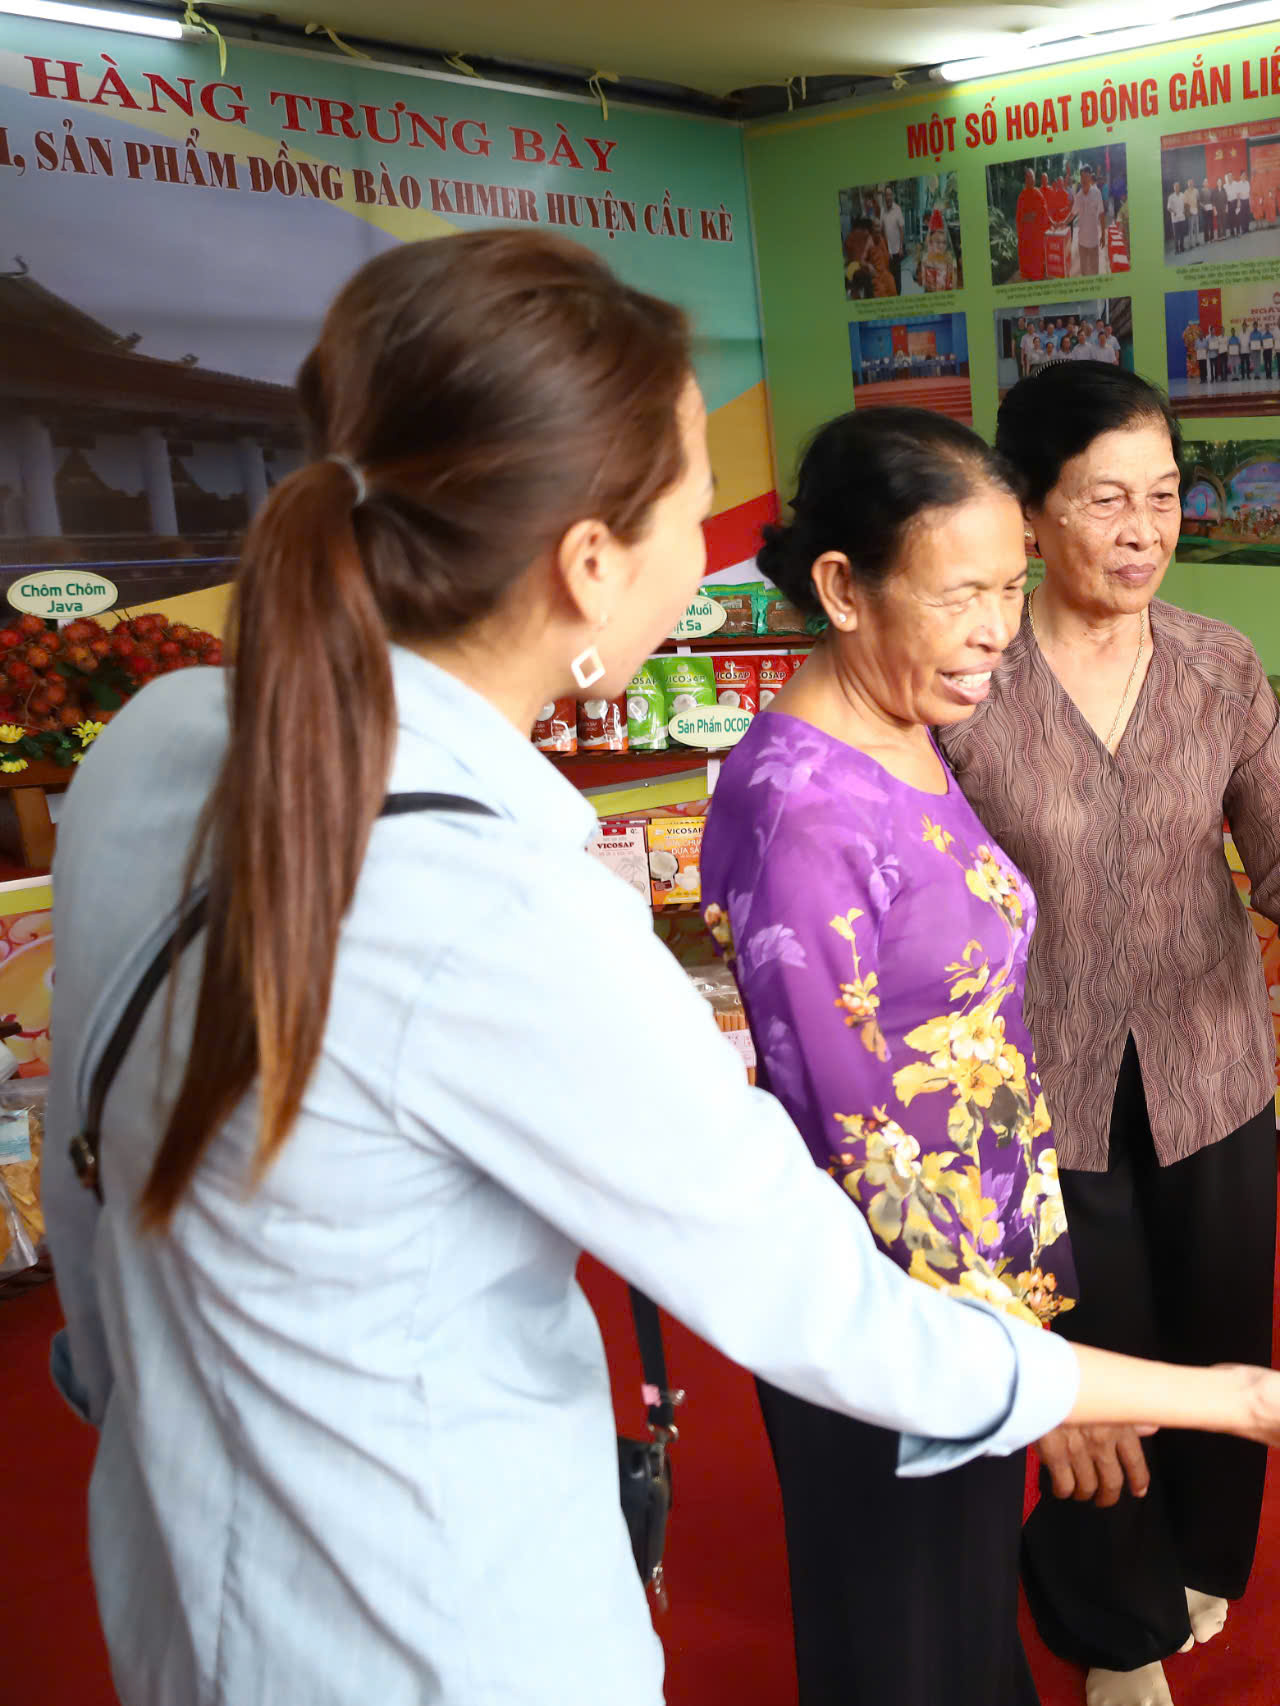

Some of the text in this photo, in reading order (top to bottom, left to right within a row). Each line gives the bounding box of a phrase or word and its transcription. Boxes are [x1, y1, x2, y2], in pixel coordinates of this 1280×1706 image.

[24, 53, 617, 173] HÀNG TRƯNG BÀY
[907, 112, 957, 162] MỘT
[965, 96, 998, 148] SỐ
[1007, 94, 1072, 144] HOẠT
[1081, 79, 1159, 133] ĐỘNG
[1169, 54, 1231, 112] GẮN
[34, 118, 114, 176] SẢN
[124, 127, 240, 190] PHẨM
[247, 140, 345, 201] ĐỒNG
[352, 161, 421, 210] BÀO
[429, 178, 540, 223] KHMER
[546, 189, 637, 239] HUYỆN
[644, 188, 693, 238] CẦU
[701, 203, 733, 242] KÈ
[20, 582, 106, 598] Chôm Chôm
[47, 600, 83, 613] Java
[686, 602, 712, 616] Muối
[686, 620, 702, 631] Sa
[723, 717, 750, 732] OCOP
[597, 841, 635, 849] VICOSAP
